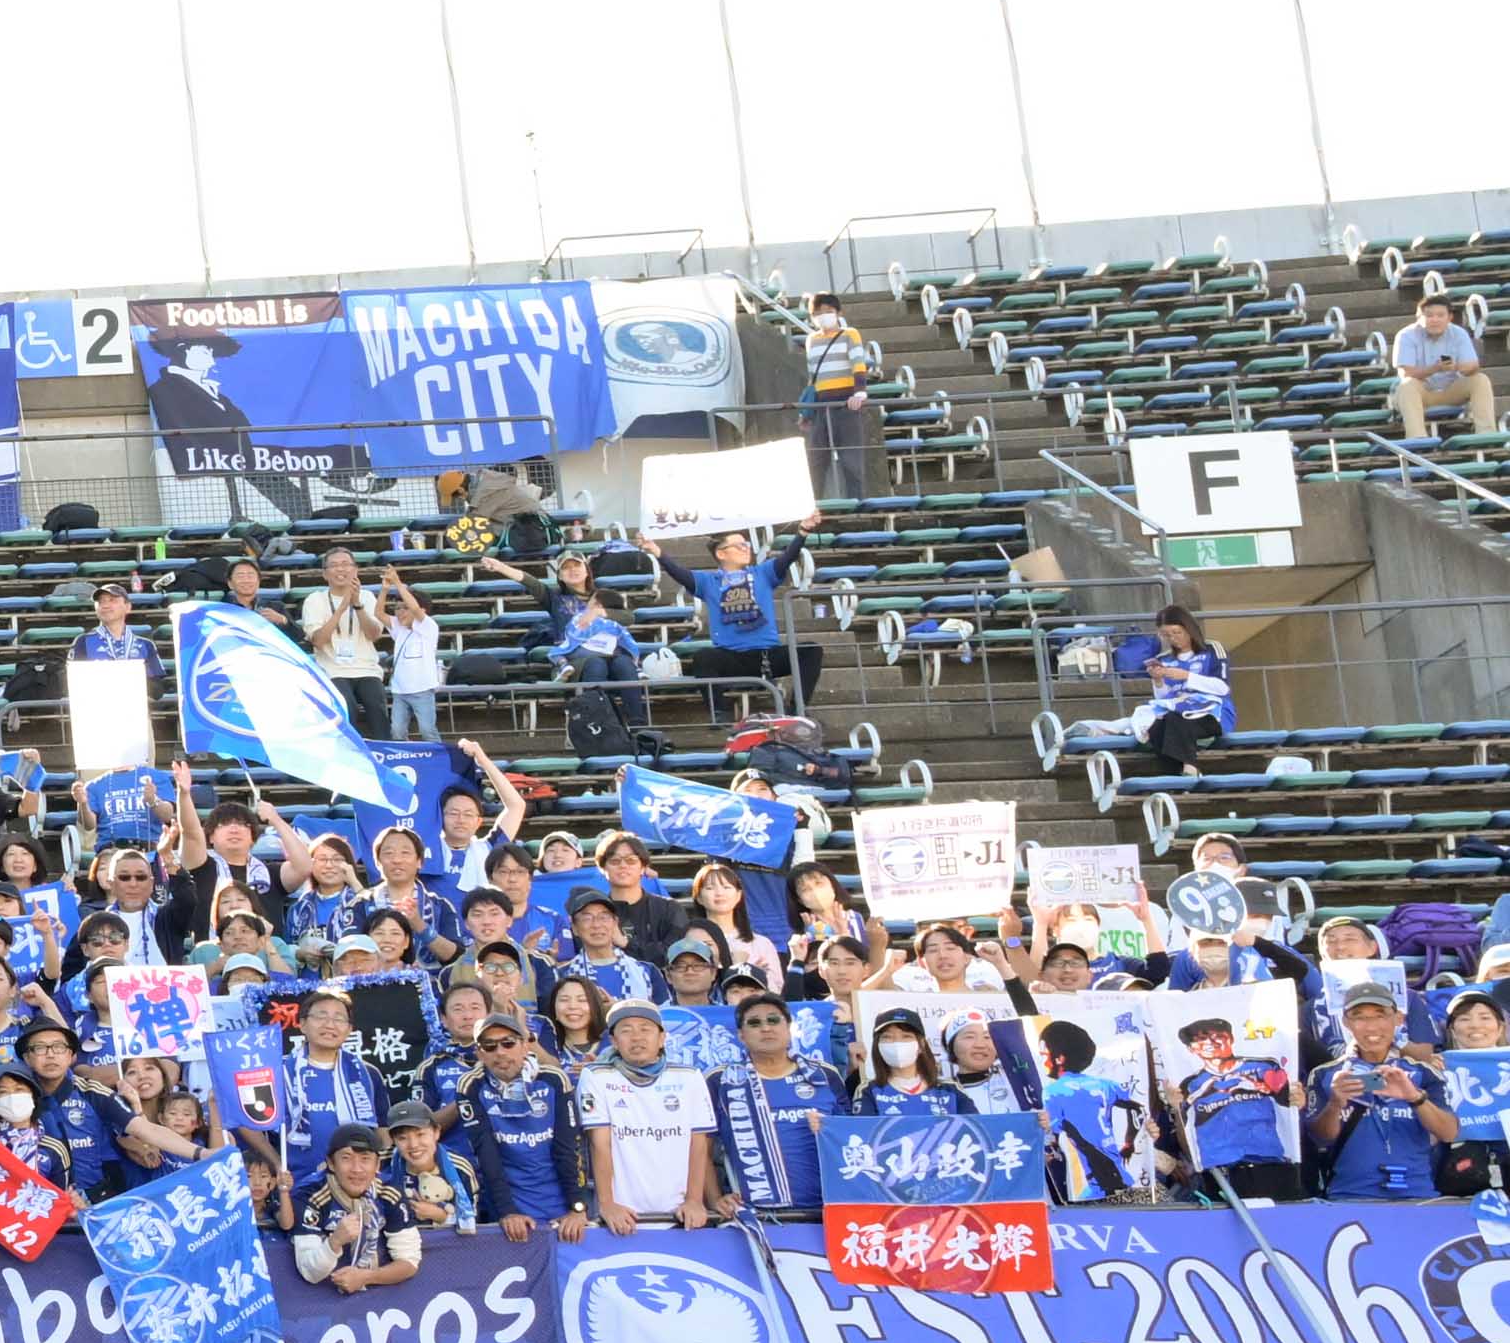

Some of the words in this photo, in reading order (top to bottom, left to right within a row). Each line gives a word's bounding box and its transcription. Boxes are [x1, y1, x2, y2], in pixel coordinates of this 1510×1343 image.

[165, 301, 268, 328] Football
[279, 300, 308, 325] is
[82, 307, 120, 366] 2
[354, 294, 590, 389] MACHIDA
[416, 352, 554, 458] CITY
[186, 446, 244, 473] Like
[251, 448, 334, 479] Bebop
[1188, 448, 1240, 517] F
[974, 839, 1008, 866] J1
[1178, 887, 1214, 927] 9
[117, 1033, 143, 1056] 16
[240, 1054, 264, 1069] J1
[729, 1083, 768, 1202] MACHIDA
[0, 1222, 39, 1256] 42
[840, 1220, 1039, 1273] 福井光輝
